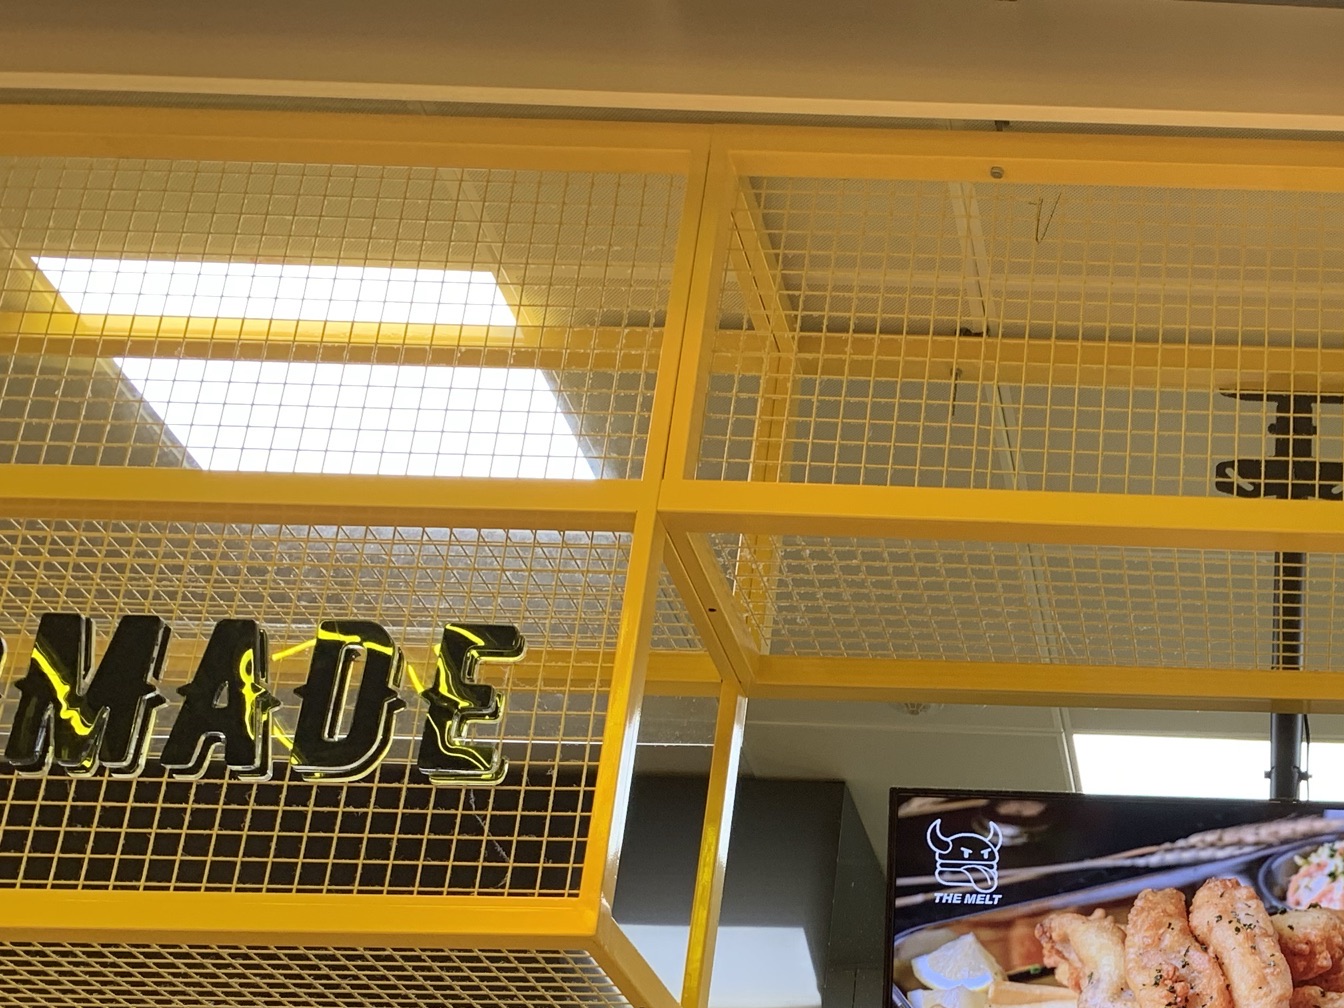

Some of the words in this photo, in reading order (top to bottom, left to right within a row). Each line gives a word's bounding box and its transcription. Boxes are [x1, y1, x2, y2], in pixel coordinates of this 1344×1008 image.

[0, 613, 525, 784] MADE
[933, 893, 962, 904] THE
[964, 893, 1002, 905] MELT
